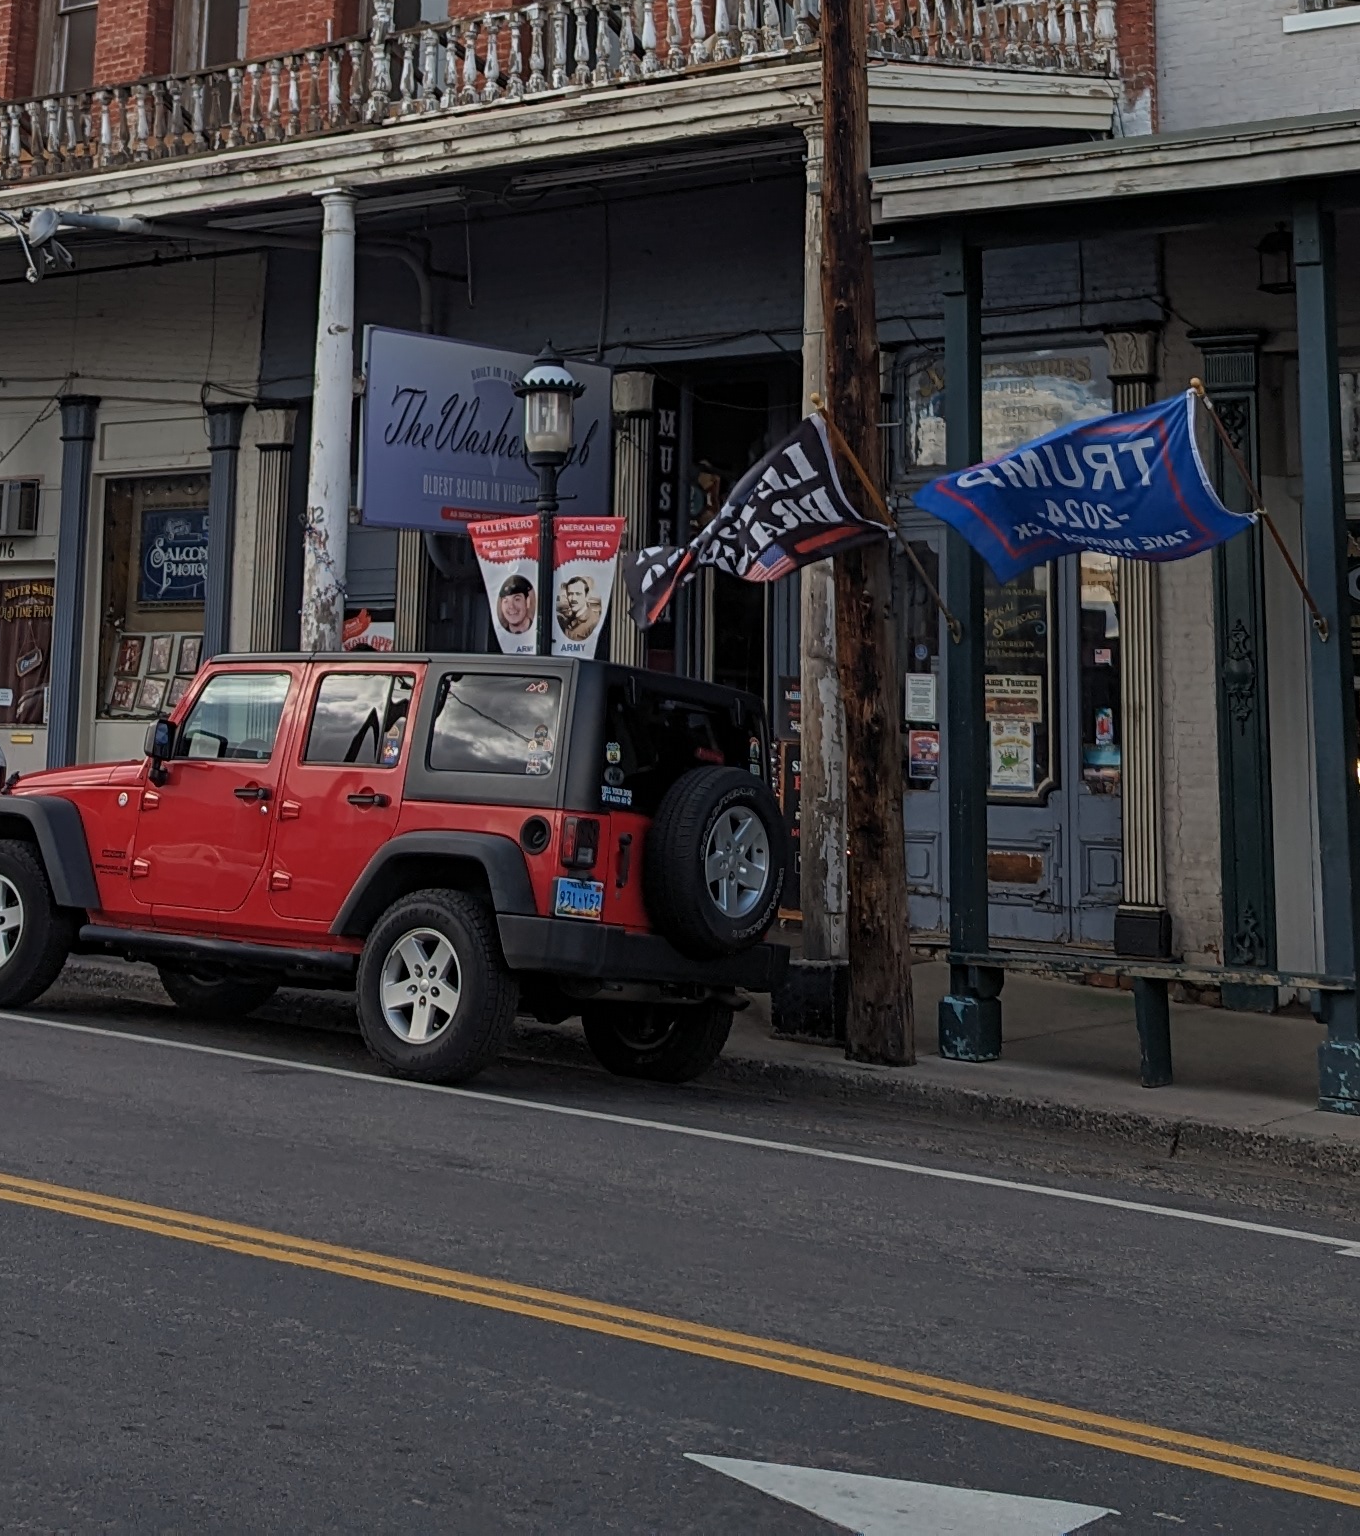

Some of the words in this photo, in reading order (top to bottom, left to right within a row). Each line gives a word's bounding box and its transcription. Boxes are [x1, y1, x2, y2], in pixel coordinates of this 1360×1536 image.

[384, 384, 433, 448] The
[435, 393, 526, 459] Washo
[423, 474, 453, 496] OLDEST
[456, 478, 488, 500] SALOON
[491, 482, 500, 501] IN
[475, 522, 508, 534] FALLEN
[509, 519, 533, 531] HERO
[558, 524, 595, 532] AMERICAN
[595, 524, 616, 532] HERO
[33, 604, 54, 618] PHOT
[561, 643, 586, 652] ARMY
[985, 679, 1004, 687] AHOE
